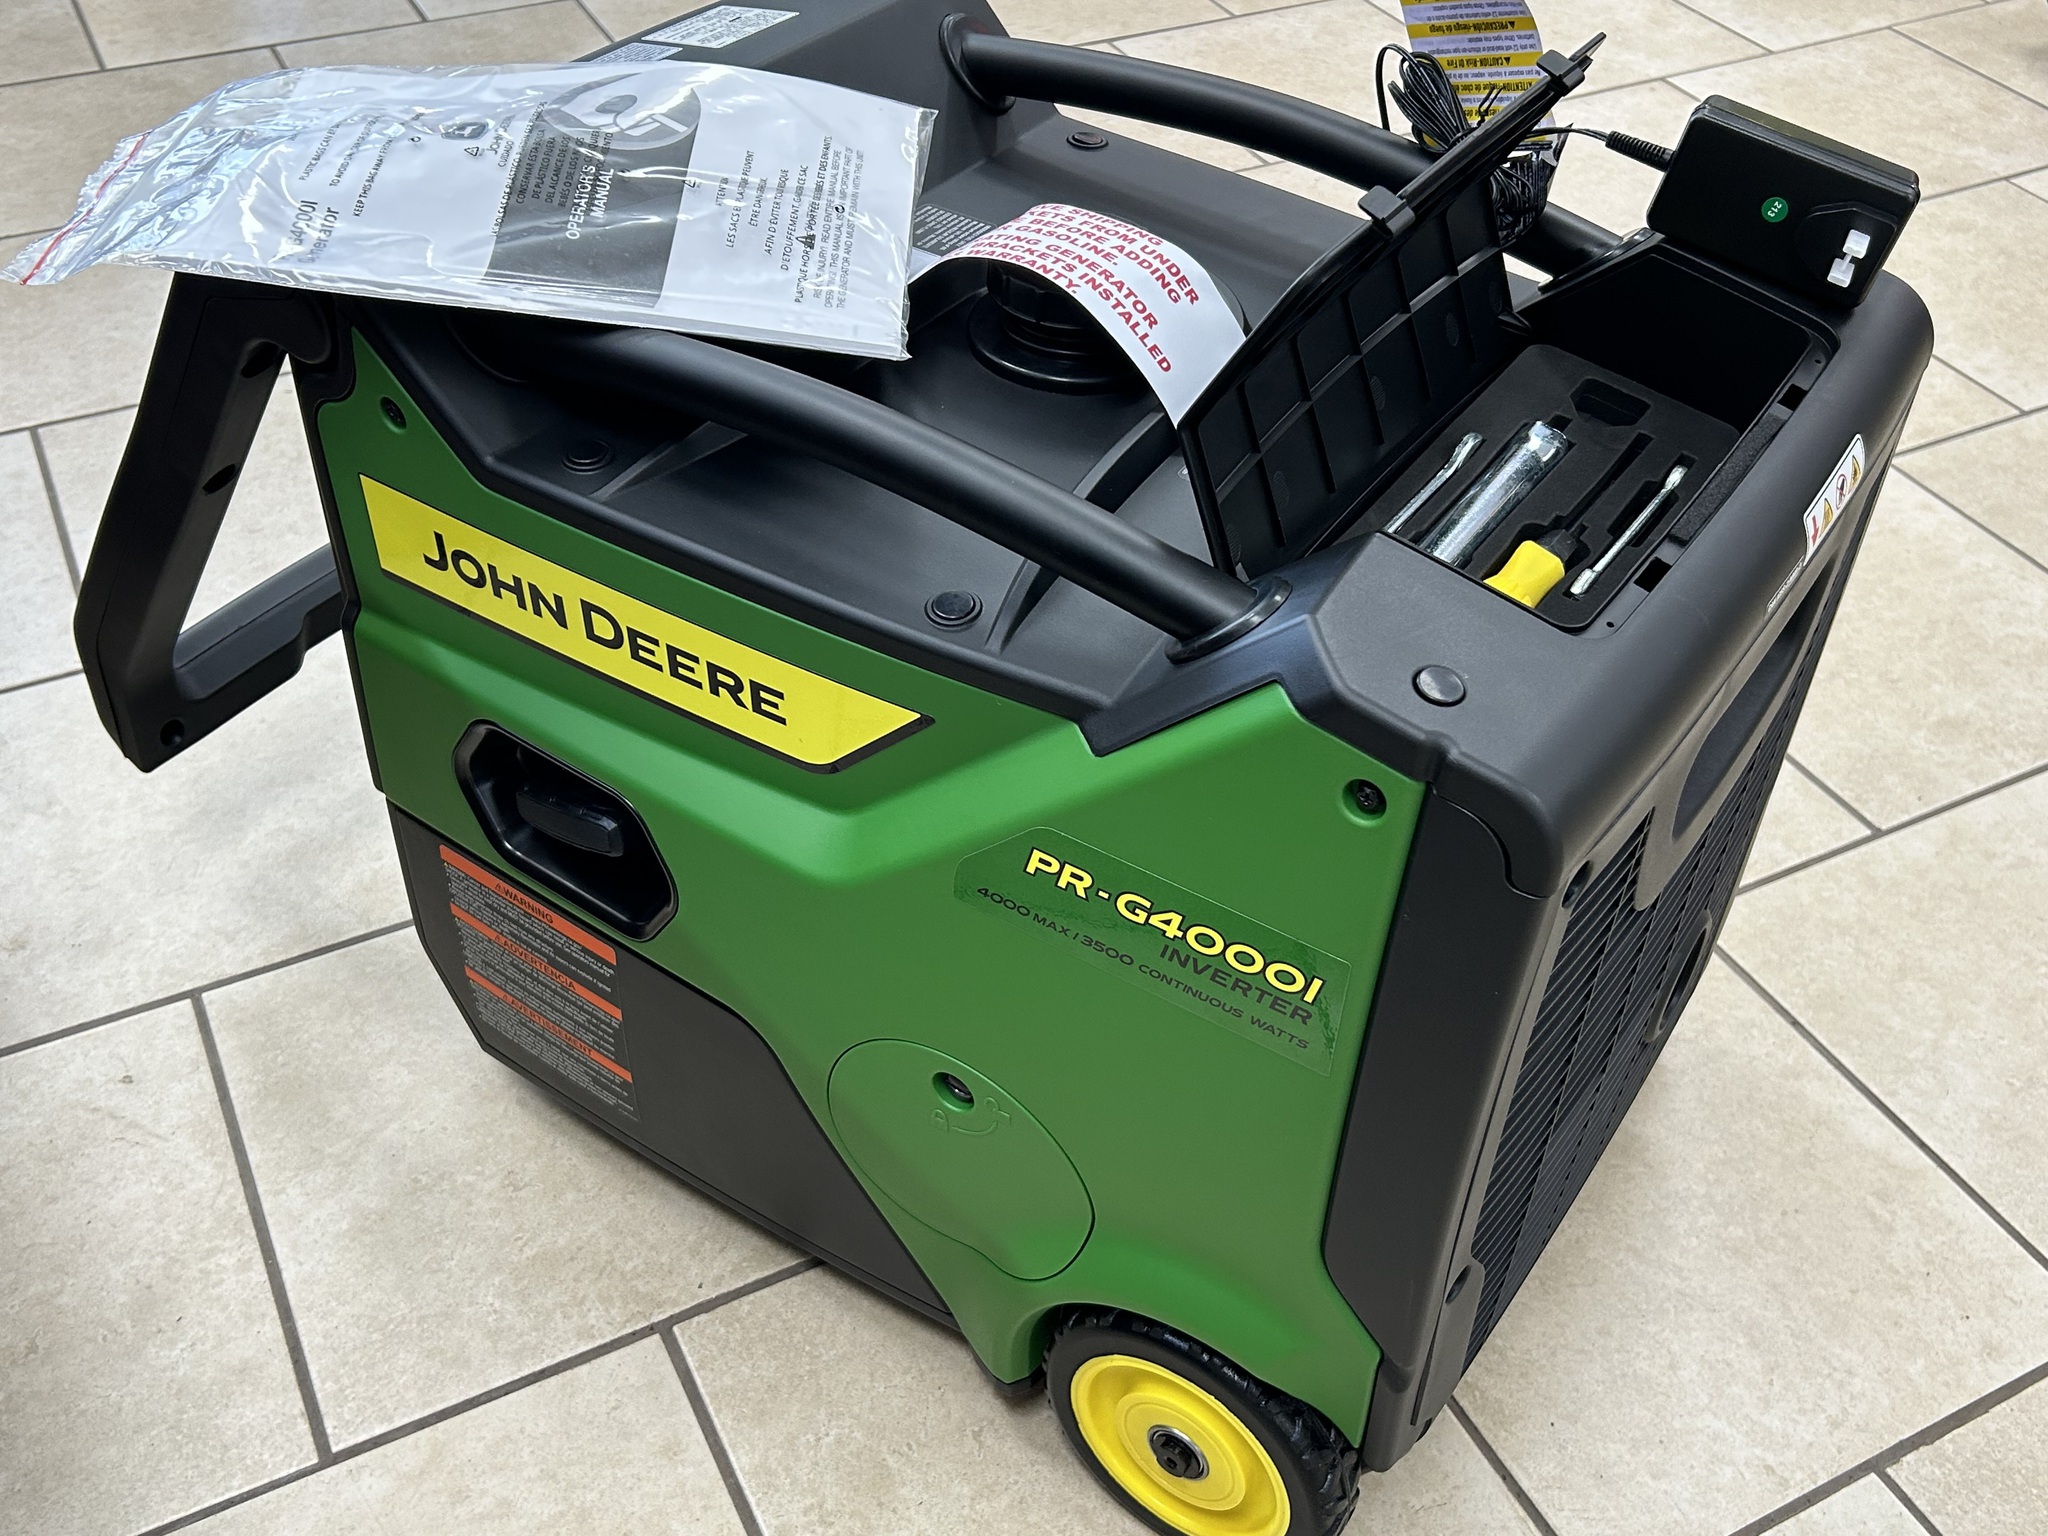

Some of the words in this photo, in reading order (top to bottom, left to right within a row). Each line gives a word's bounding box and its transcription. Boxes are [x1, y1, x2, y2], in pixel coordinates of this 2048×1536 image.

[1445, 25, 1452, 33] de
[1446, 59, 1458, 69] Fire
[486, 134, 503, 154] JOHN
[543, 137, 556, 156] FUERA
[557, 148, 567, 157] DE
[561, 136, 570, 148] LOS
[298, 161, 318, 180] PLASTIC
[312, 147, 326, 161] BAGS
[320, 135, 334, 147] CAN
[372, 154, 386, 171] AWAY
[498, 141, 514, 167] CUIDADO
[568, 157, 578, 169] LOS
[741, 150, 754, 176] PEUVENT
[830, 150, 842, 170] BEFORE
[335, 161, 350, 178] AVOID
[516, 163, 535, 204] CONSERVAR
[528, 147, 540, 162] ESTA
[532, 157, 550, 189] PLÁSTICO
[549, 159, 565, 190] ALCANCE
[565, 171, 575, 180] DE
[798, 165, 808, 177] SAC
[818, 160, 828, 171] DES
[366, 171, 378, 183] BAG
[797, 177, 806, 185] CE
[826, 172, 839, 197] MANUAL
[358, 184, 372, 199] THIS
[502, 190, 512, 200] DE
[531, 189, 542, 199] DE
[544, 191, 555, 203] DEL
[565, 164, 595, 239] OPERATOR'S
[590, 168, 614, 218] MANUAL
[353, 199, 364, 217] KEEP
[767, 201, 781, 233] D'ÉVITER
[823, 198, 834, 223] ENTIRE
[1767, 200, 1783, 218] 213
[728, 213, 740, 233] SACS
[821, 224, 831, 243] READ
[845, 218, 856, 240] MUST
[1067, 208, 1164, 247] SHIPPING
[725, 233, 736, 248] LES
[764, 234, 775, 255] AFIN
[832, 223, 844, 252] MANUAL
[844, 240, 853, 256] AND
[1014, 224, 1121, 267] GASOLINE.
[817, 246, 828, 272] INJURY!
[829, 253, 839, 270] THIS
[1030, 217, 1112, 245] BEFORE
[1110, 244, 1183, 305] ADDING
[1082, 217, 1137, 245] FROM
[1139, 244, 1200, 306] UNDER
[966, 248, 1083, 295] WARRANTY.
[1043, 242, 1160, 331] GENERATOR
[836, 296, 846, 308] THE
[971, 240, 1080, 274] BRACKETS
[1077, 271, 1174, 374] INSTALLED
[422, 530, 569, 631] JOHN
[579, 597, 788, 727] DEERE
[502, 885, 554, 925] WARNING
[502, 938, 577, 993] ADVERTENCIA
[976, 886, 1032, 918] 4000
[1032, 913, 1070, 938] MAX
[1081, 935, 1136, 967] 3500
[1137, 963, 1245, 1019] CONTINUOUS
[1249, 1014, 1311, 1050] WATTS
[1158, 943, 1315, 1026] INVERTER
[510, 998, 594, 1057] AVERTISSEMENT
